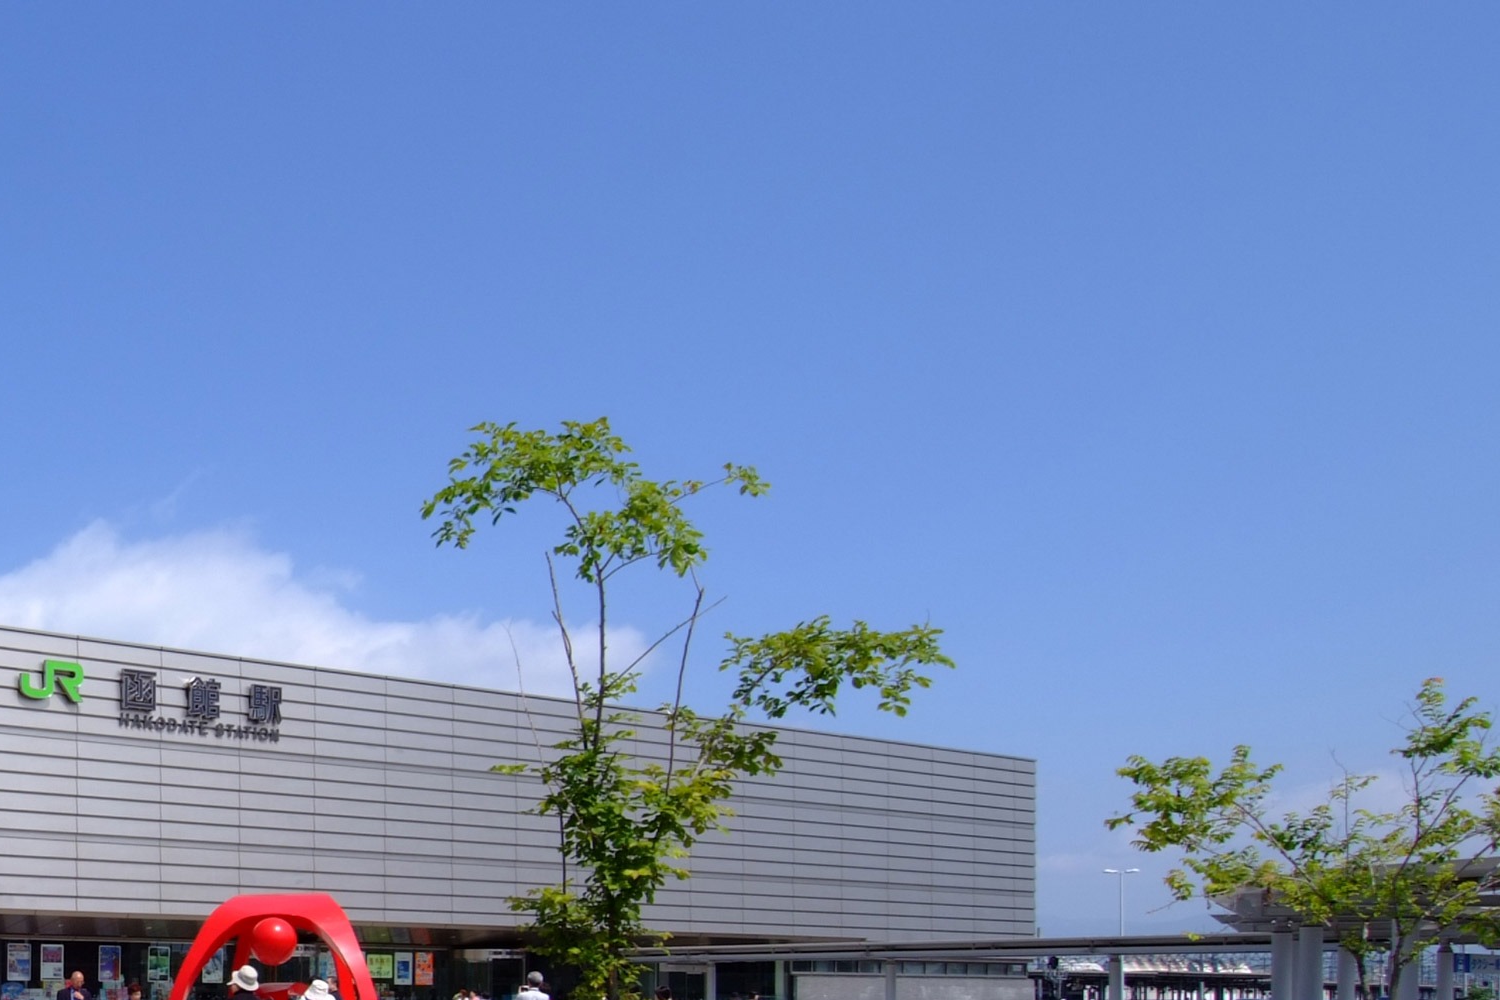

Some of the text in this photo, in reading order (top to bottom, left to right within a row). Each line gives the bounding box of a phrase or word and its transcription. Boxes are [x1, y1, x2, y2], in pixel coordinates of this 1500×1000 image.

[19, 659, 84, 703] JR
[120, 668, 283, 725] 函館駅
[118, 712, 280, 743] HAKODATE STATION
